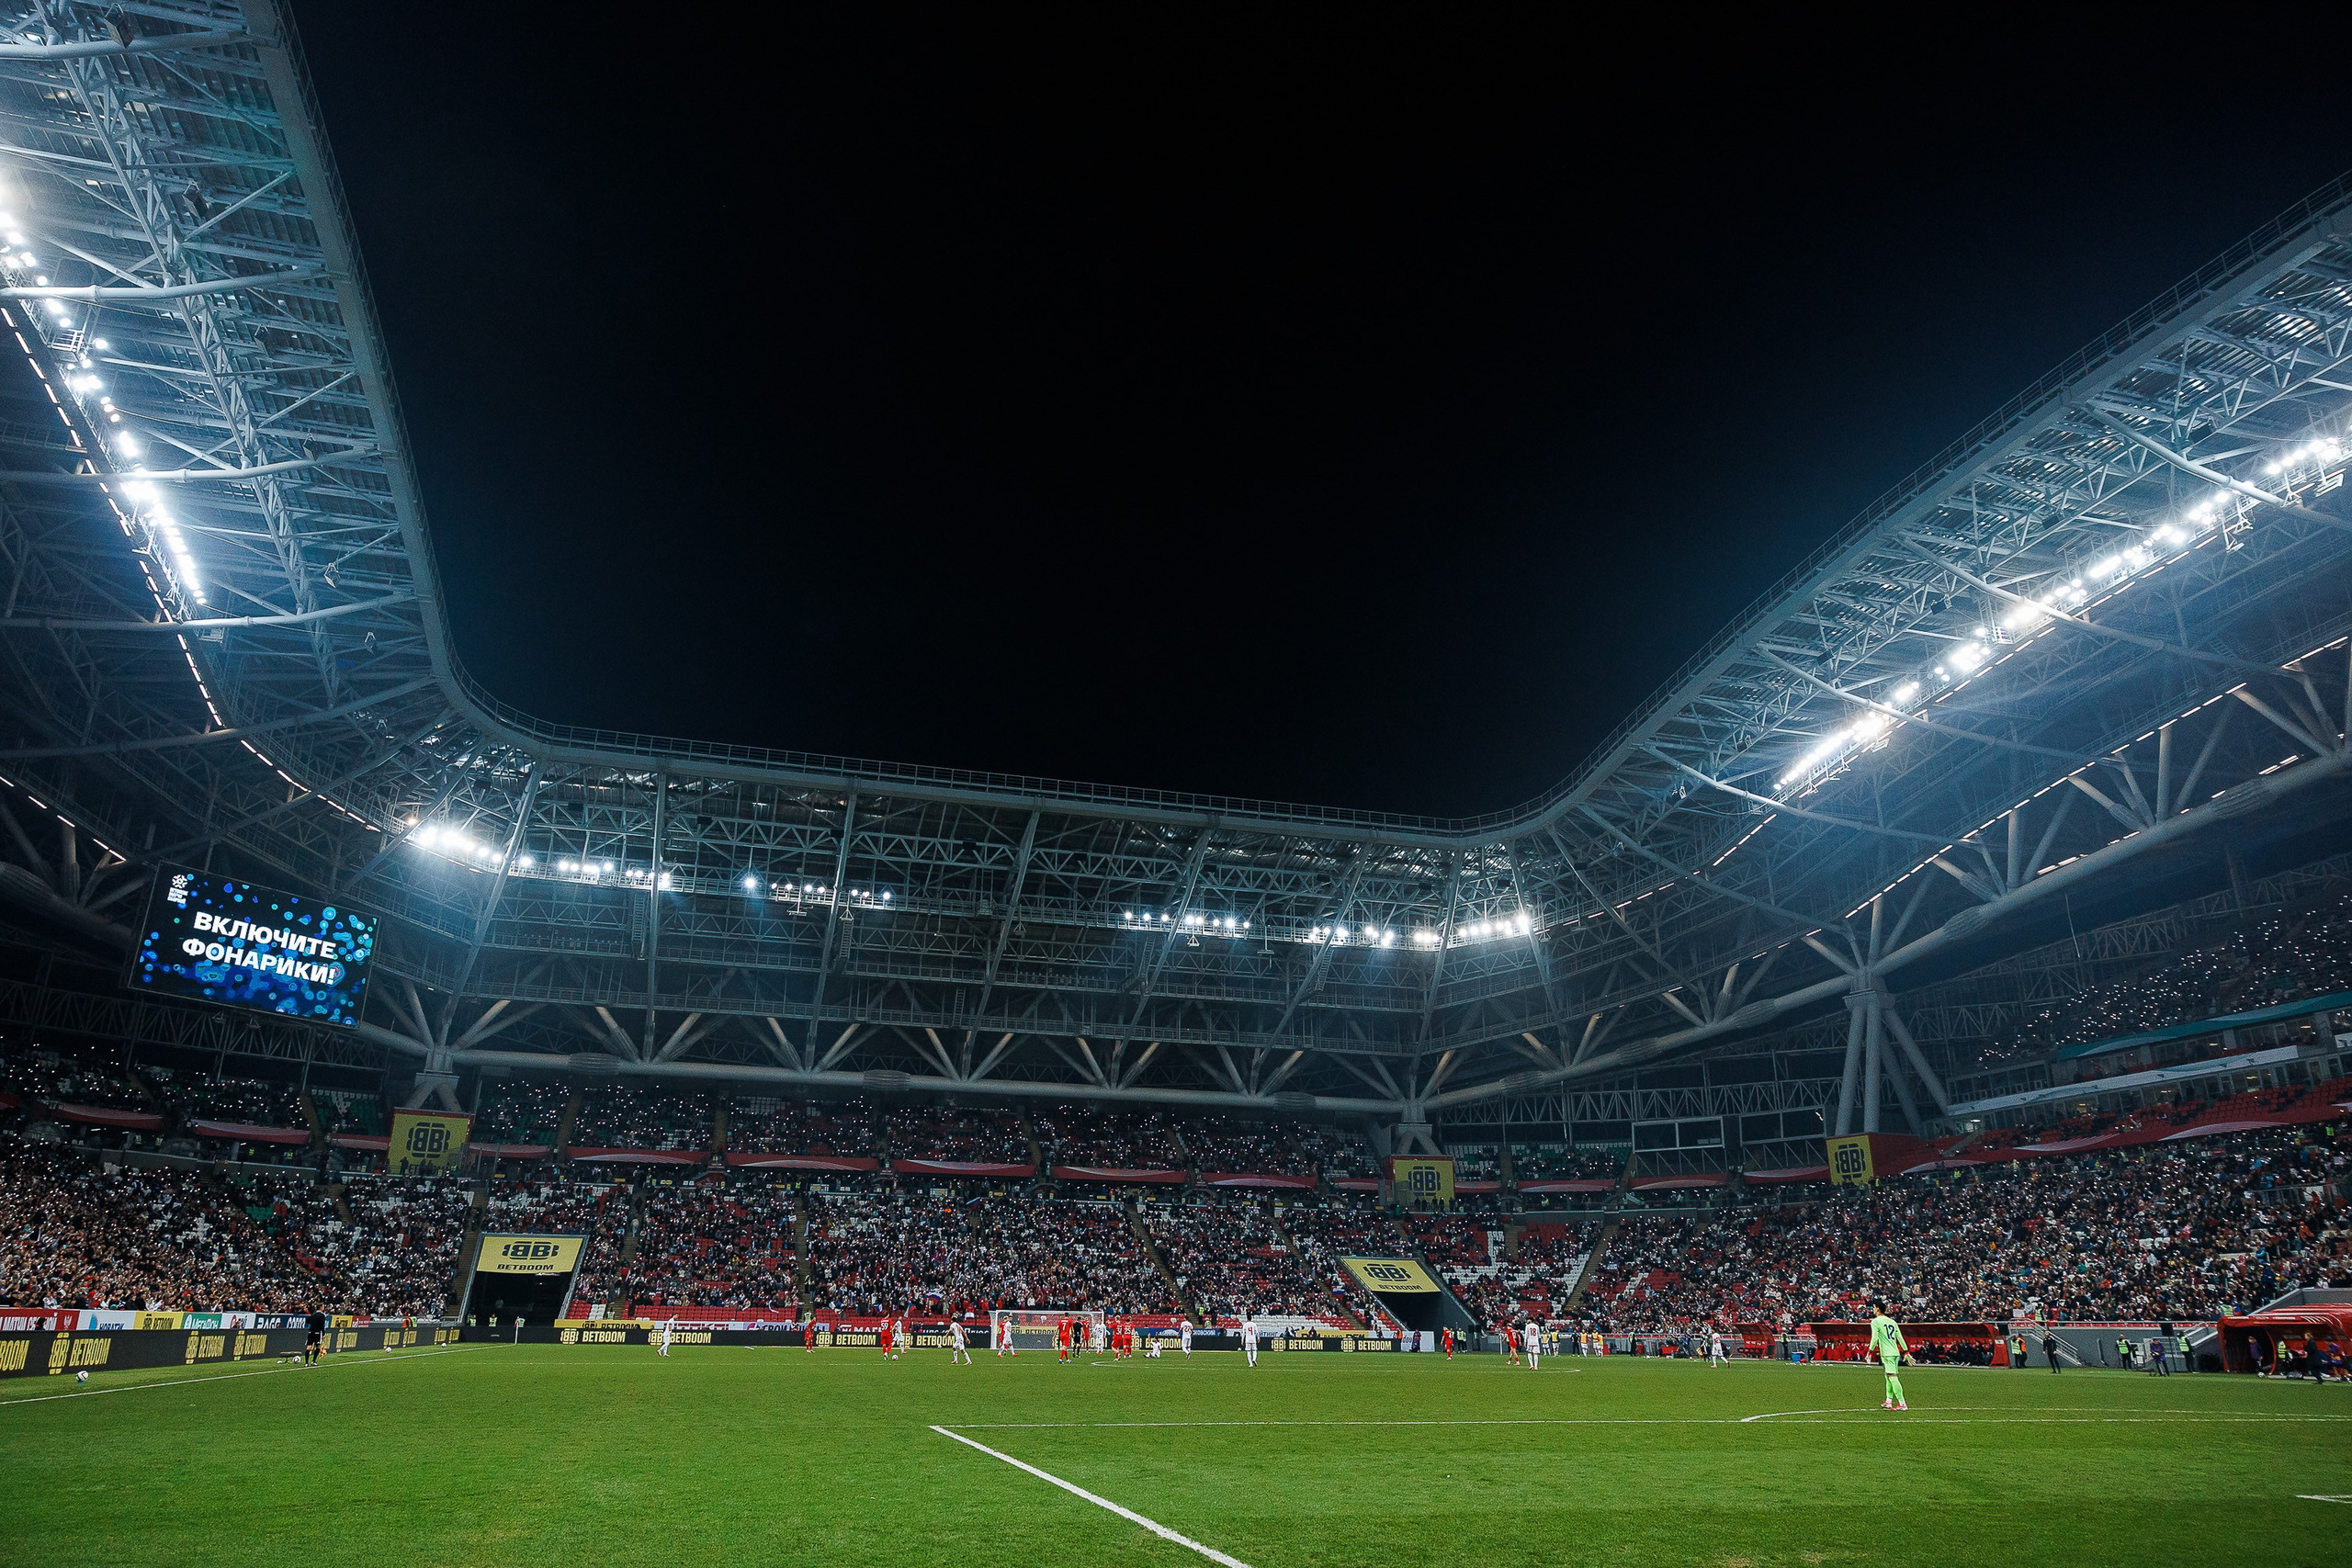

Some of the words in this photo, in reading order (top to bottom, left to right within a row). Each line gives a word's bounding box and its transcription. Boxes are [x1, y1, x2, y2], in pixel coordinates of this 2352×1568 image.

[193, 911, 336, 959] ВКЛЮЧИТЕ
[182, 938, 337, 985] ФОНАРИКИ!
[582, 1331, 626, 1343] BETBOOM
[670, 1332, 711, 1344] BETBOOM
[1530, 1328, 1537, 1337] 18
[1883, 1325, 1895, 1340] 12
[836, 1335, 876, 1346] BETBOOM
[916, 1336, 956, 1347] BETBOOM
[1289, 1340, 1323, 1350] BETBOOM
[1358, 1340, 1392, 1351] BETBOOM
[69, 1338, 111, 1367] BETBOOM
[198, 1336, 225, 1359] BETBOOM
